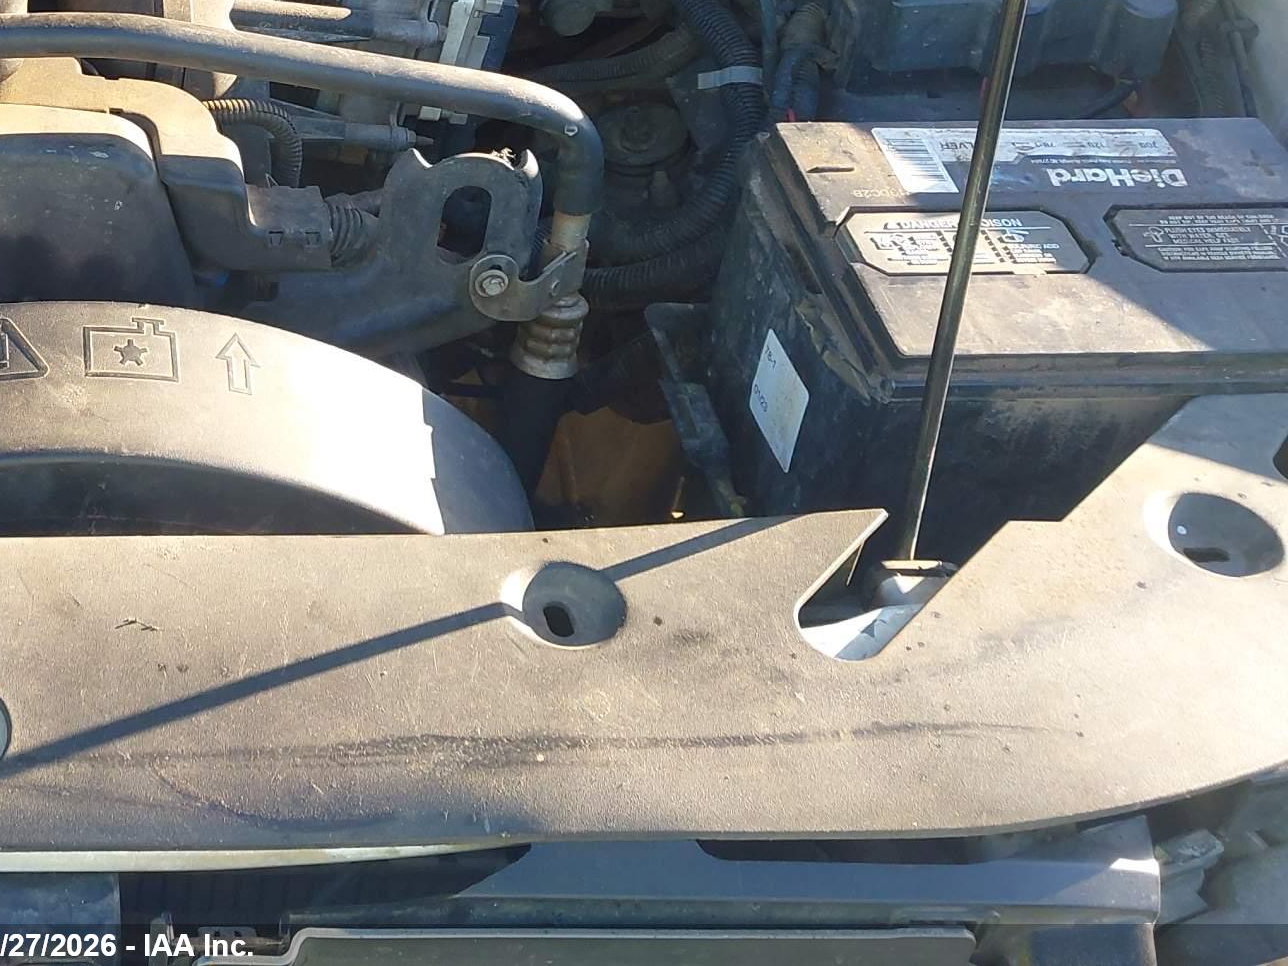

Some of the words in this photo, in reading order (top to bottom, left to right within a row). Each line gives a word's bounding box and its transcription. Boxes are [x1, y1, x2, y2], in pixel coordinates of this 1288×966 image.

[939, 141, 974, 150] LVER
[1048, 168, 1188, 187] DieHard
[980, 218, 1023, 227] OISON
